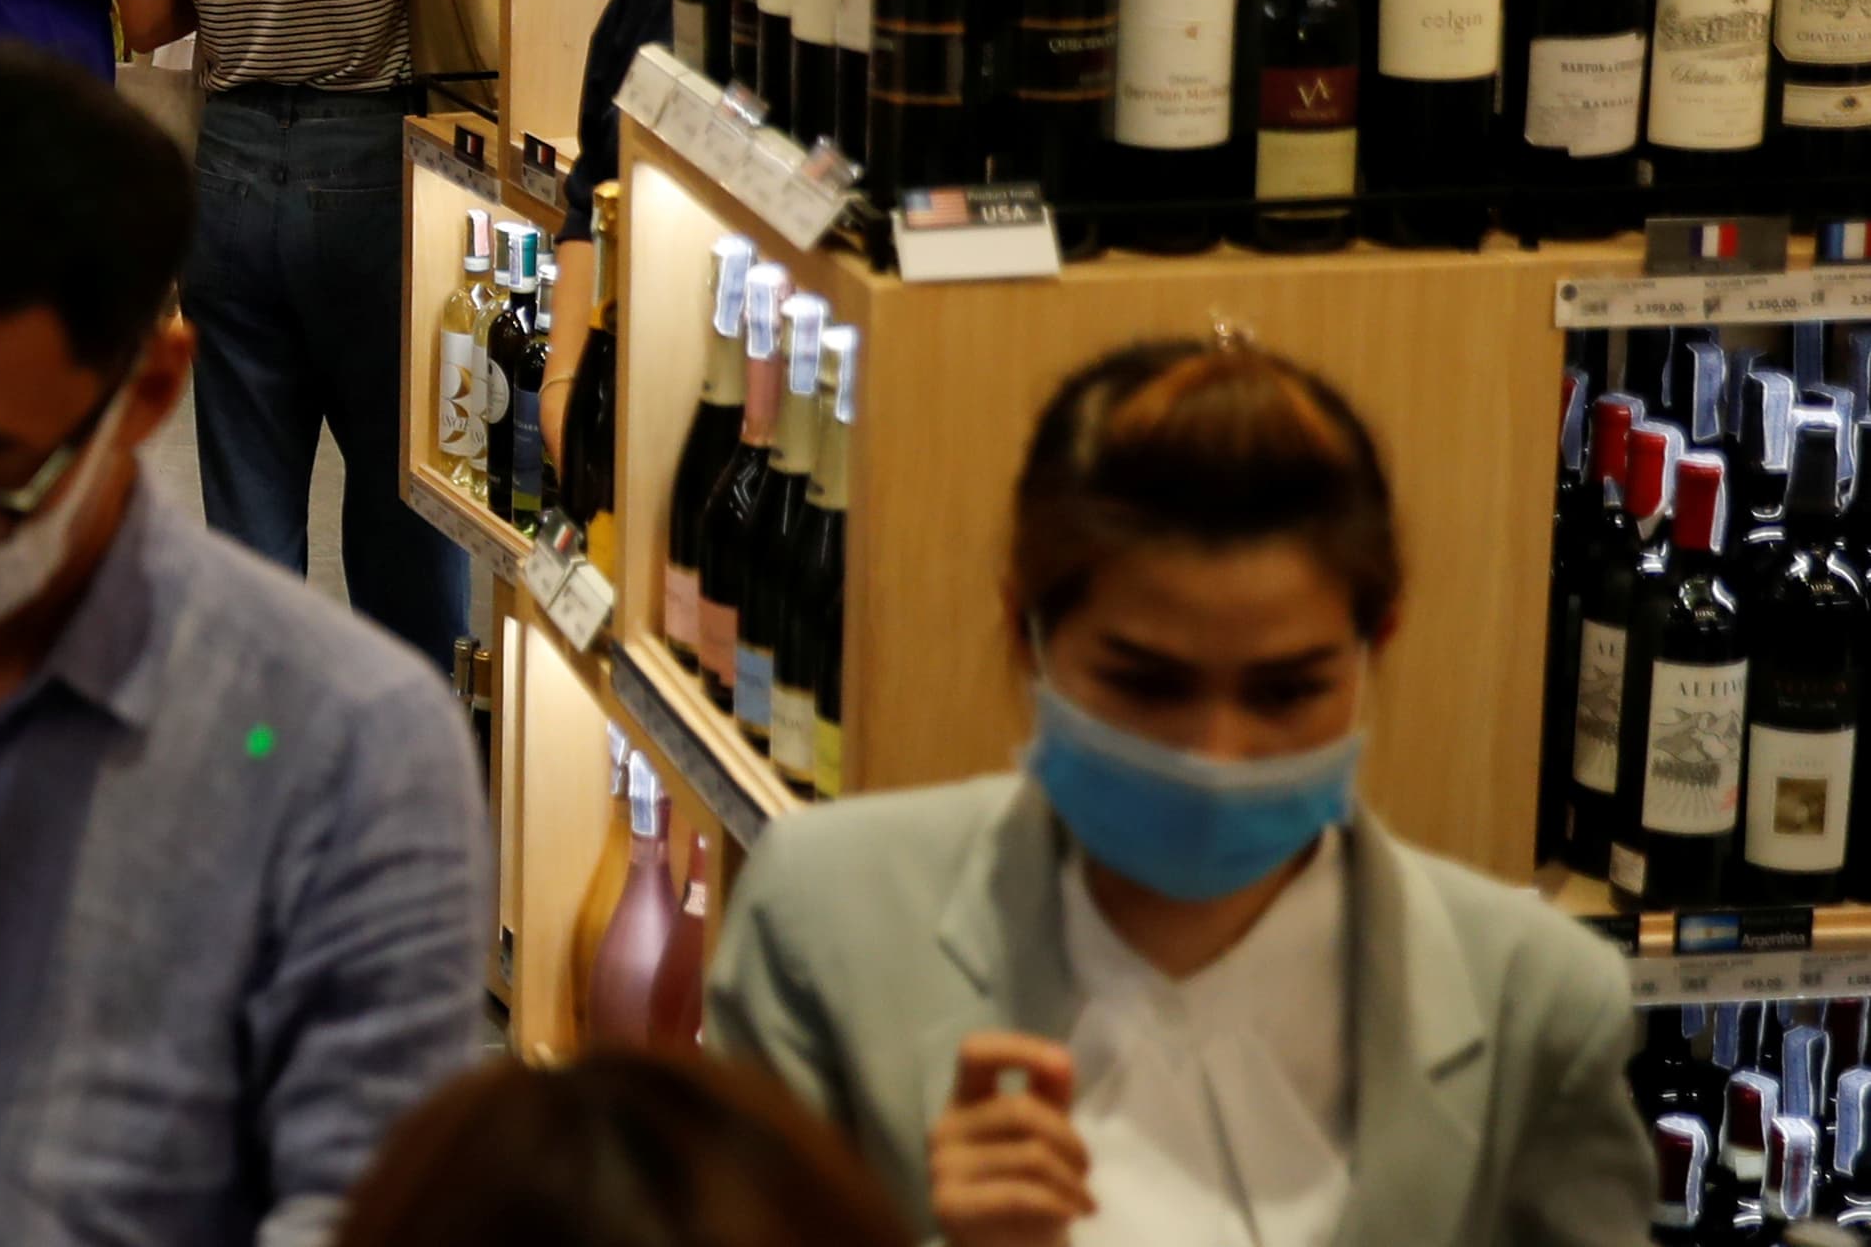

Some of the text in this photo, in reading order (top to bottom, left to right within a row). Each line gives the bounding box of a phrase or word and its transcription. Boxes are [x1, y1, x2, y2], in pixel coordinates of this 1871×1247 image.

[1421, 8, 1483, 35] colgin
[981, 204, 1027, 223] USA
[1741, 933, 1806, 947] Argentina
